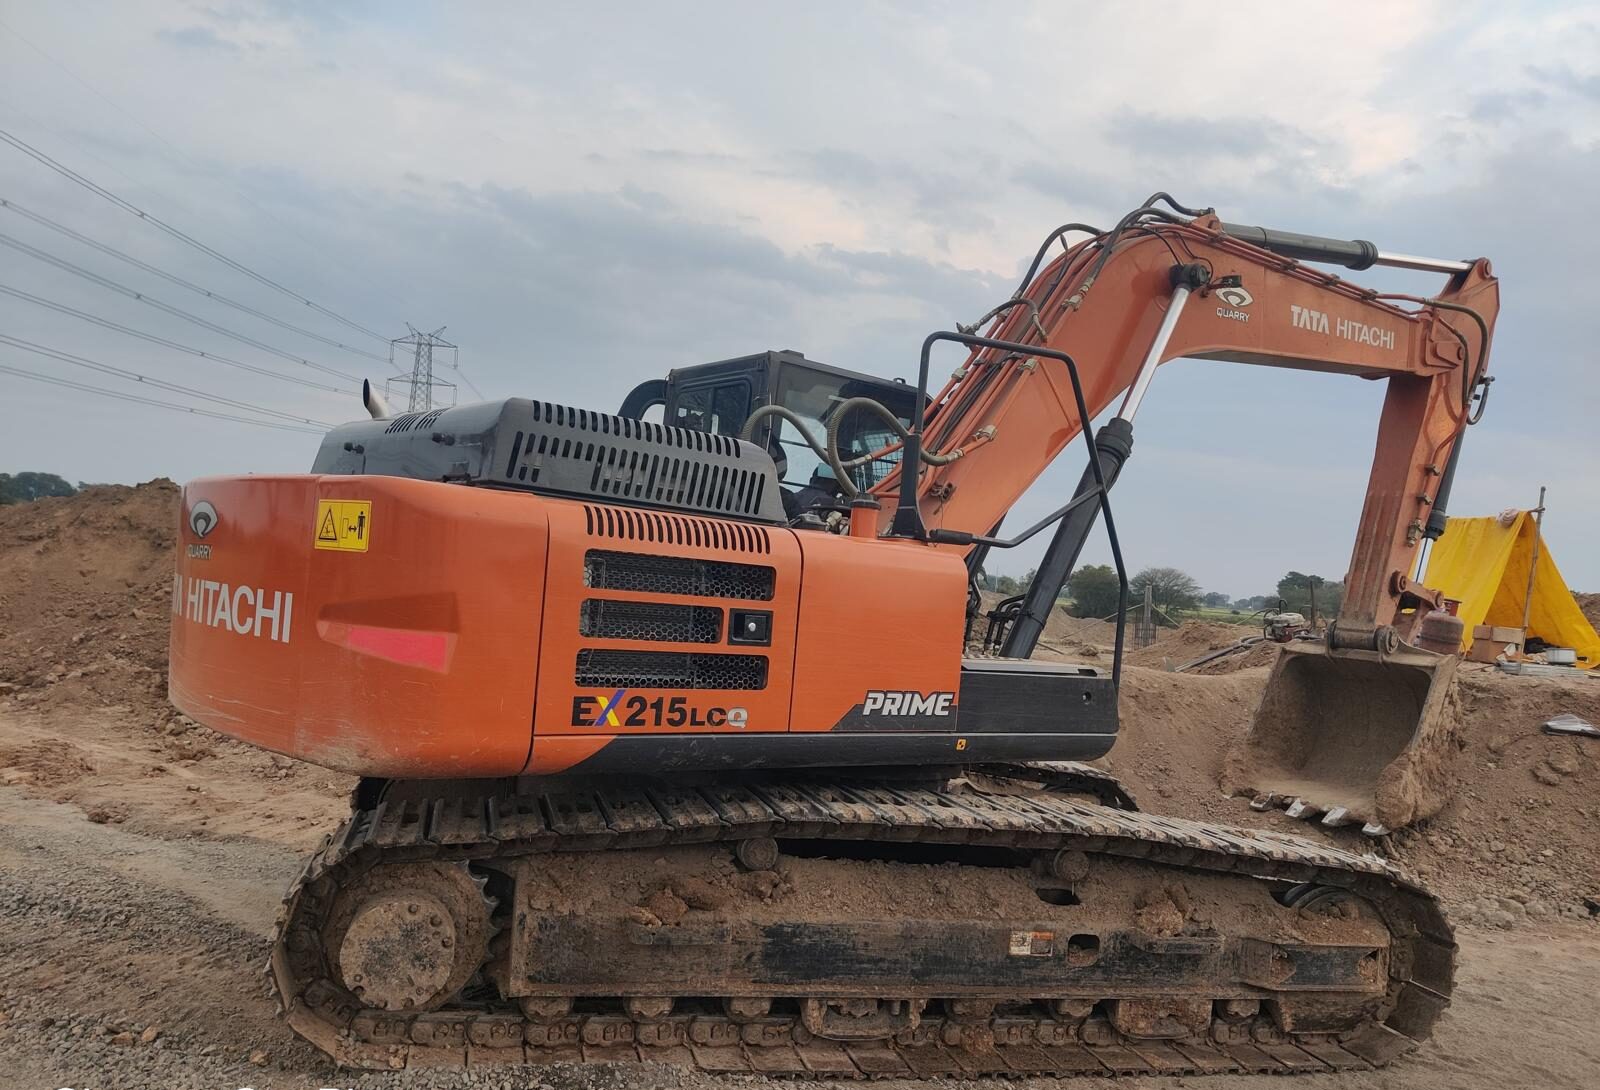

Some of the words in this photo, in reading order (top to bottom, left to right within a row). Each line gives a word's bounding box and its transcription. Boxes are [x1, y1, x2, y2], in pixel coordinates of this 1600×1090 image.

[1216, 307, 1250, 323] QUARRY
[1290, 304, 1330, 335] TATA
[1336, 317, 1394, 350] HITACHI
[187, 544, 213, 560] QUARRY
[186, 577, 293, 643] HITACHI
[862, 691, 954, 716] PRIME
